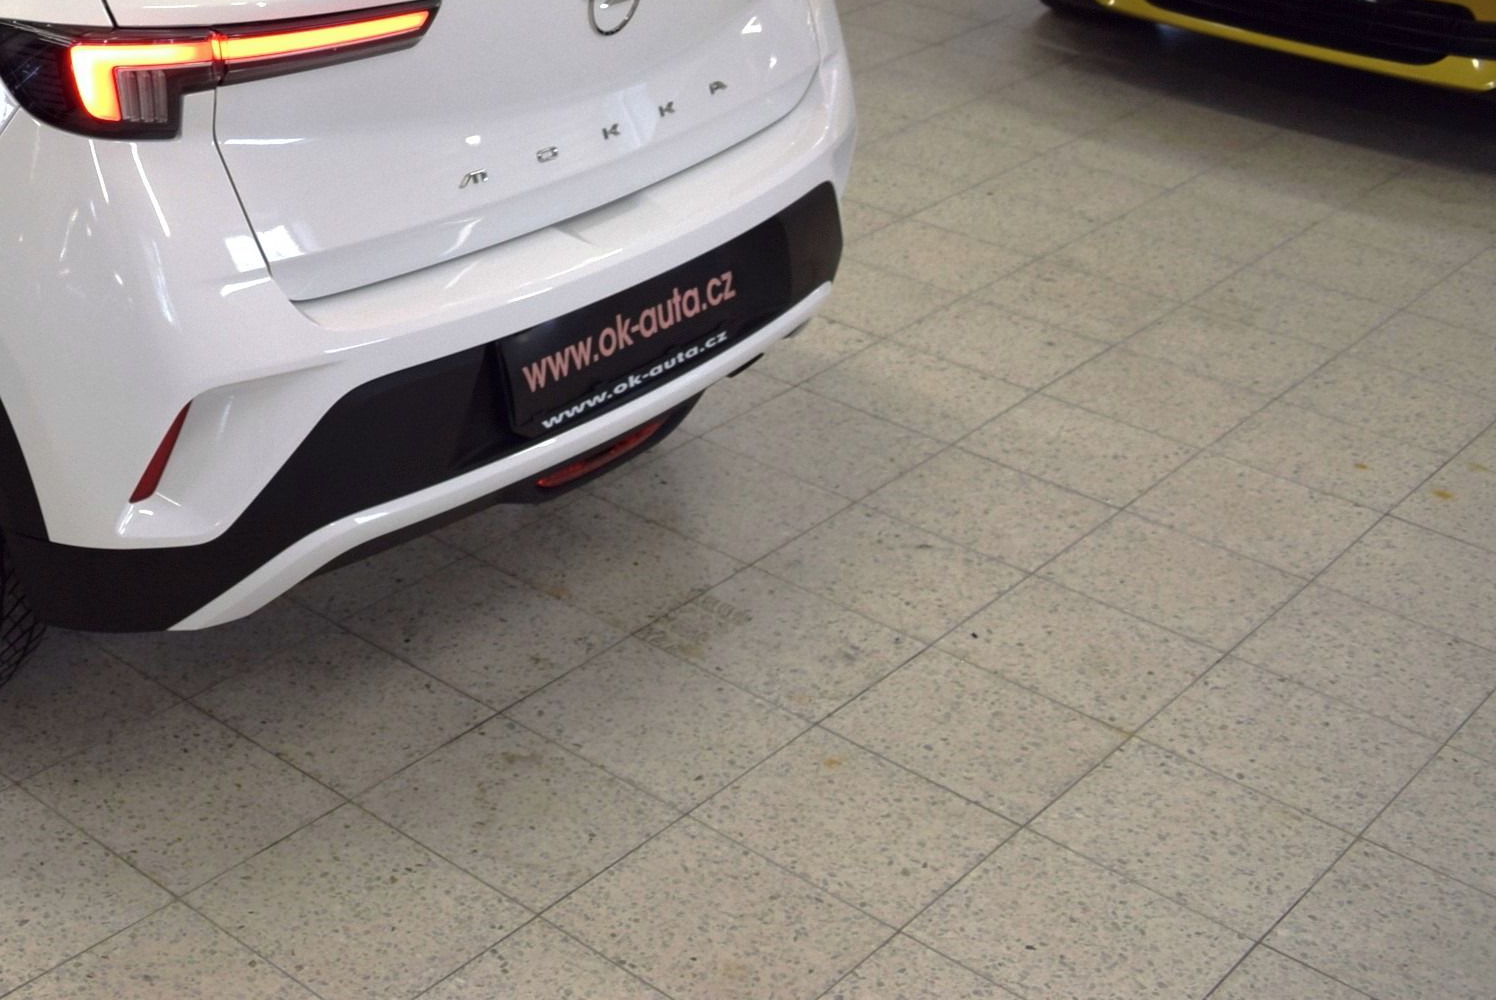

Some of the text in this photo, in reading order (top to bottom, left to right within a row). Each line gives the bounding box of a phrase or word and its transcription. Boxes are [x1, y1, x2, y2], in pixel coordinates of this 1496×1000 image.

[458, 80, 729, 189] MOKKA
[521, 270, 737, 394] www.ok-auta.cz
[540, 329, 729, 430] www.ok-auta.cz
